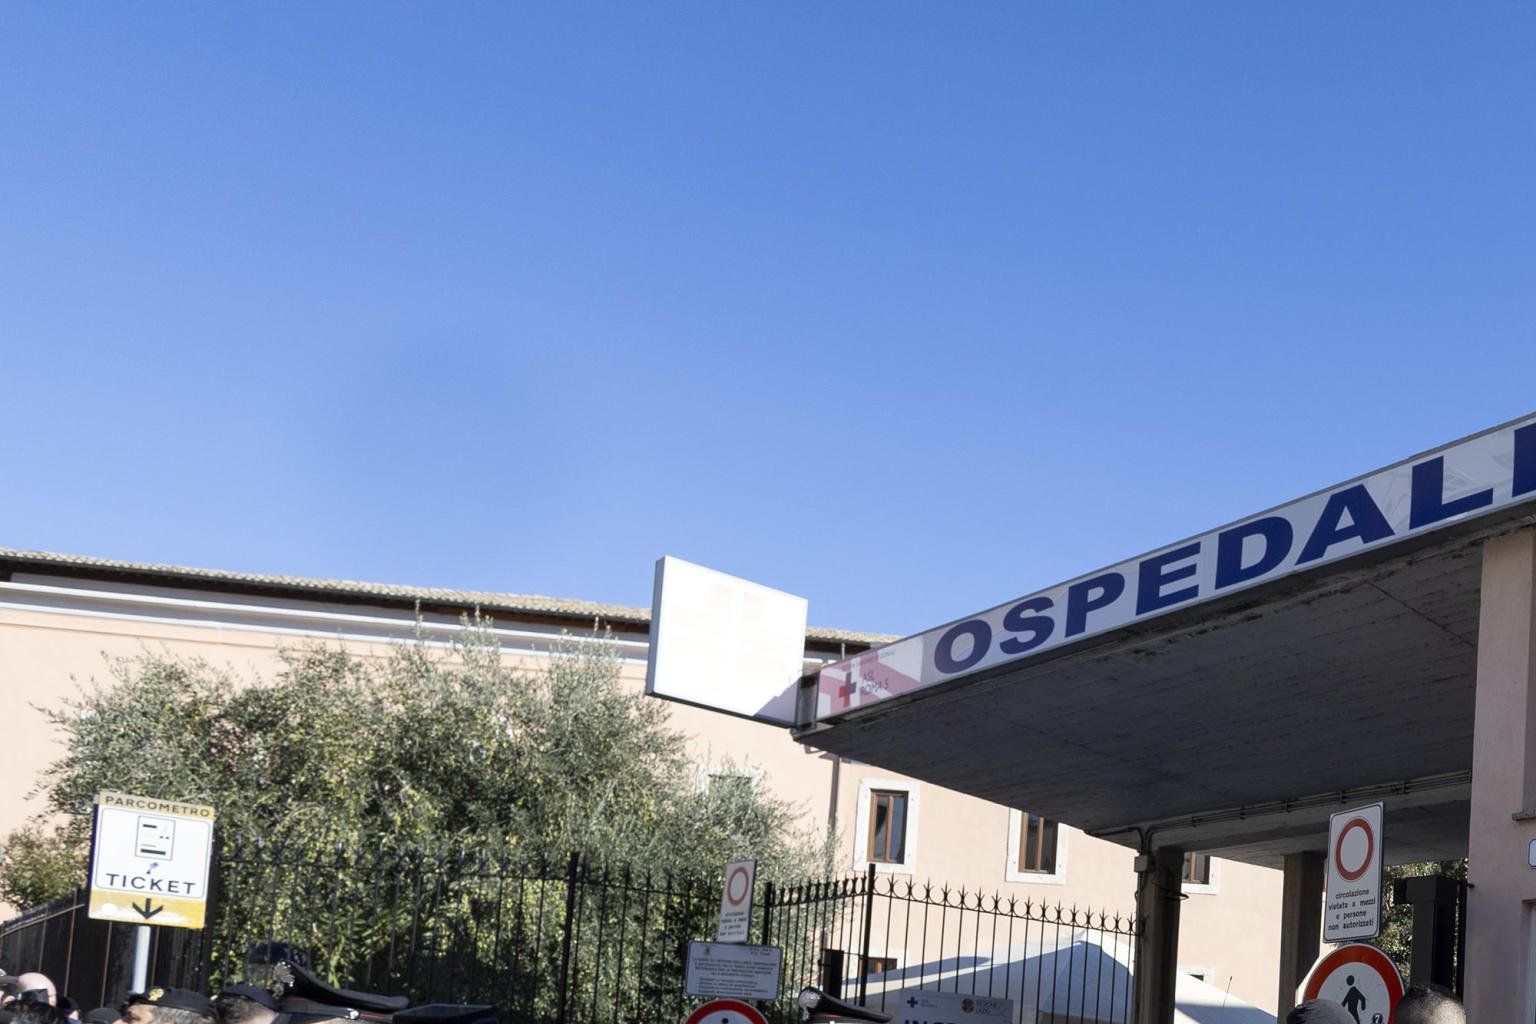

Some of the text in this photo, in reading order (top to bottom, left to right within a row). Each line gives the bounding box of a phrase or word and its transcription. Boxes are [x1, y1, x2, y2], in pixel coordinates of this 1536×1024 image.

[105, 795, 210, 818] PARCOMETRO
[105, 872, 196, 894] TICKET
[1335, 888, 1370, 899] circolazione
[1359, 897, 1376, 906] mezzi
[1343, 910, 1367, 920] persone
[1328, 917, 1374, 931] non autorizzati
